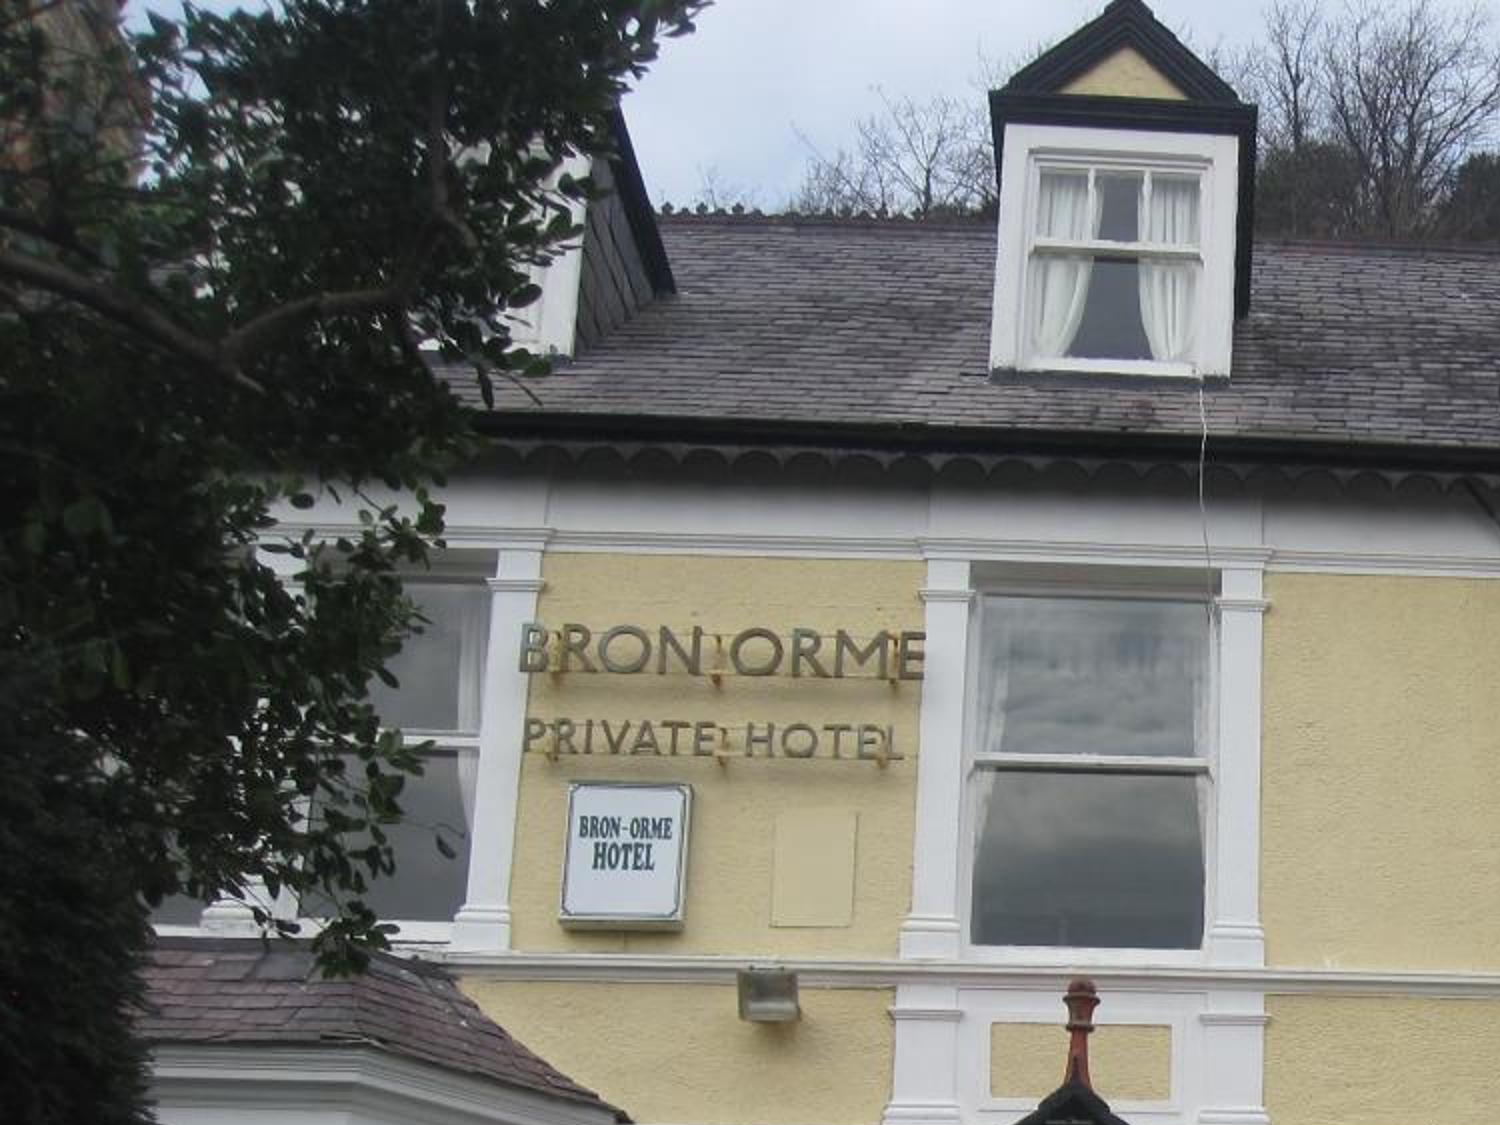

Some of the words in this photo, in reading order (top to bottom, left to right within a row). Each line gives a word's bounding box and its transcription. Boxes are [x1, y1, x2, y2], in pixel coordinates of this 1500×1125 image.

[518, 623, 703, 677] BRON
[729, 627, 927, 680] ORME
[523, 718, 716, 756] PRIVATE
[745, 722, 904, 761] HOTEL
[579, 816, 673, 839] BRON-ORME
[592, 842, 655, 871] HOTEL
